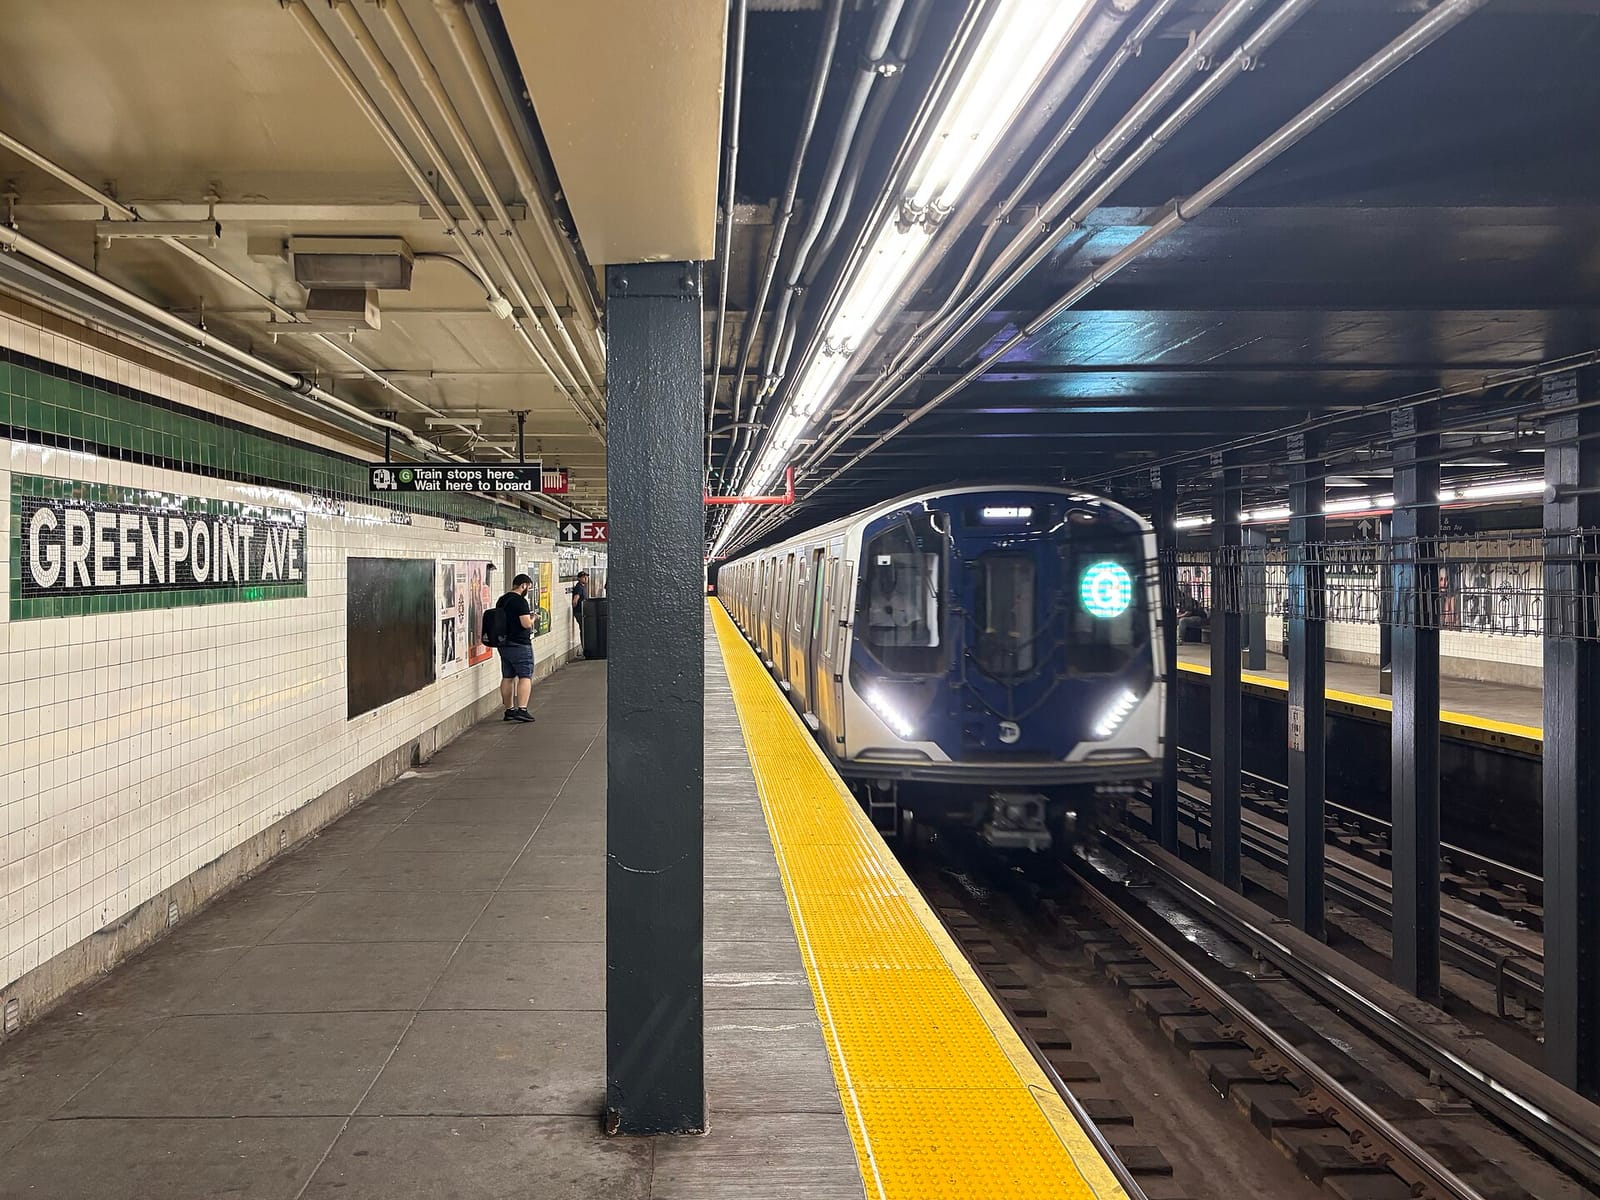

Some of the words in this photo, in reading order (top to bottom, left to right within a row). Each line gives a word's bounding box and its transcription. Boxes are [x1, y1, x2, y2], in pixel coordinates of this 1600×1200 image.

[402, 472, 410, 480] G
[414, 469, 442, 480] Train
[447, 469, 482, 484] stops
[487, 469, 514, 480] here
[414, 480, 441, 491] Wait
[445, 480, 473, 491] here
[478, 480, 490, 491] to
[495, 480, 532, 491] board
[30, 507, 253, 588] GREENPOINT
[1091, 571, 1121, 609] G
